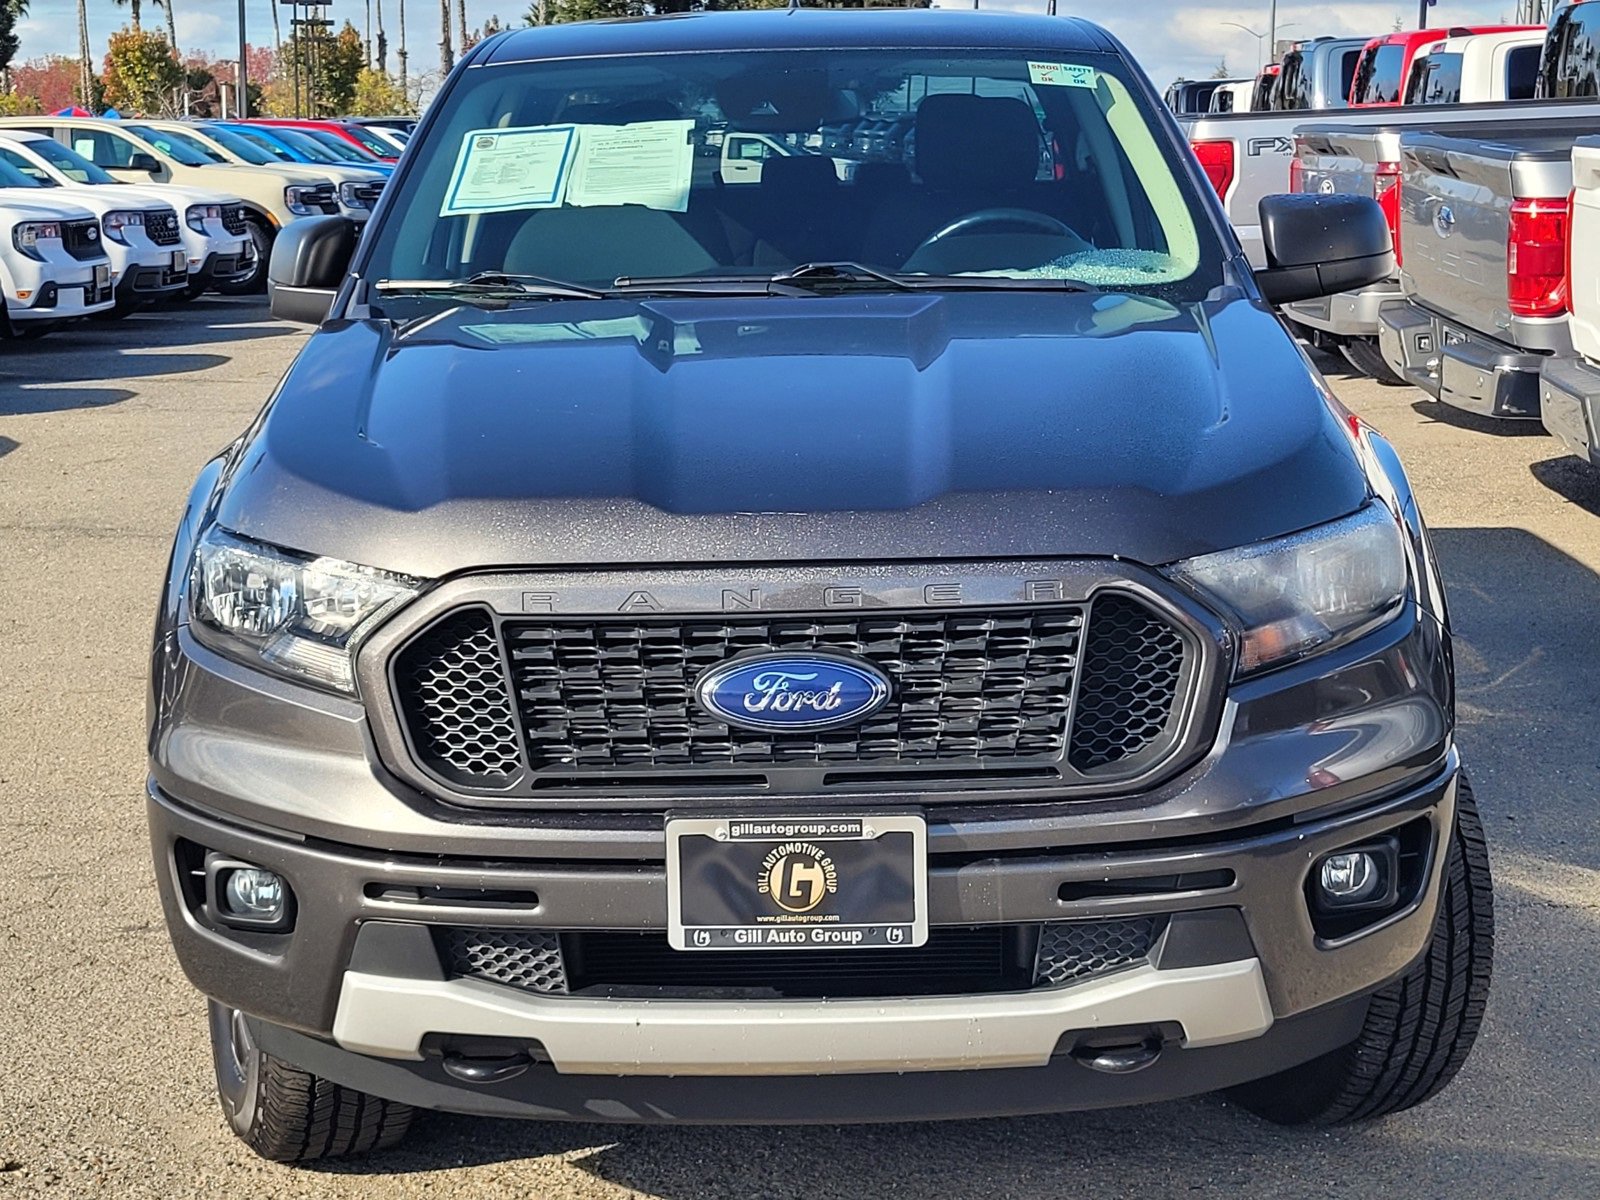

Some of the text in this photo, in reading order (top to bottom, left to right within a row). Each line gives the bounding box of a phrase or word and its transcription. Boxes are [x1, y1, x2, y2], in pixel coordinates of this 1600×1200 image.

[1063, 66, 1092, 74] SAFETY
[522, 579, 1064, 613] RANGER
[743, 671, 843, 713] Ford
[731, 823, 861, 837] gillautogroup.com
[757, 842, 838, 894] GILL AUTOMOTIVE GROUP
[756, 914, 840, 924] www.gillautogroup.com
[734, 928, 863, 945] Gill Auto Group
